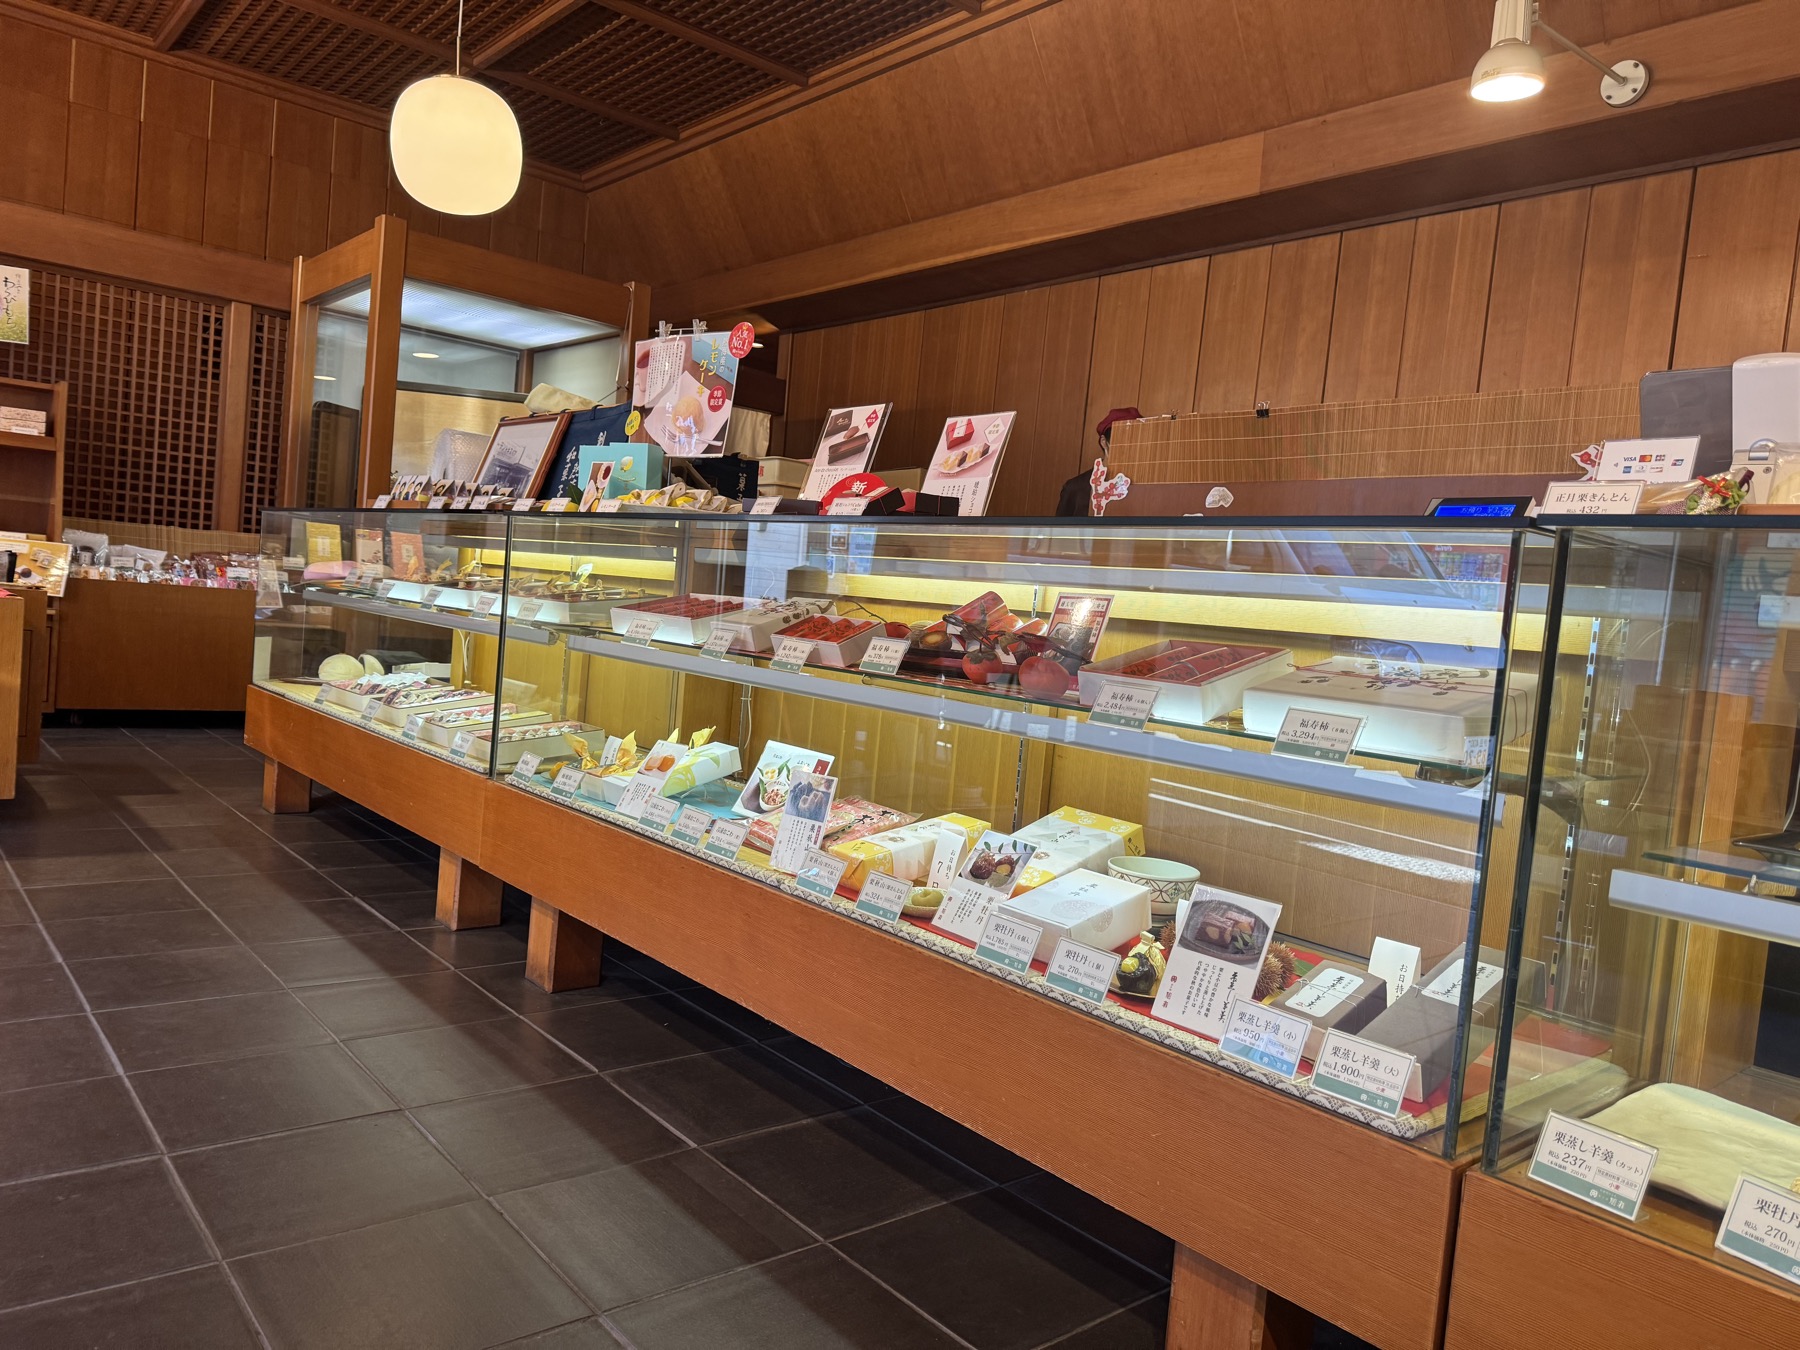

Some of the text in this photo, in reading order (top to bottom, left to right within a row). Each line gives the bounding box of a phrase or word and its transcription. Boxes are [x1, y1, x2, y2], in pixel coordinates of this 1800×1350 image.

[707, 338, 720, 376] レモン
[697, 359, 709, 397] ケーキ
[1555, 492, 1631, 503] 正月栗きんとん
[975, 896, 996, 925] 栗牡丹
[1395, 964, 1408, 1001] お日持
[1237, 1011, 1297, 1041] 栗蒸し羊羹（小）
[1242, 1027, 1265, 1043] 950円
[1330, 1045, 1400, 1077] 栗蒸し羊羹（大）
[1332, 1061, 1365, 1080] 1,900円
[1553, 1130, 1645, 1176] 栗蒸し羊羹（カット）
[1561, 1152, 1592, 1172] 237円
[1608, 1182, 1621, 1191] 小麦
[1764, 1225, 1796, 1248] 270円
